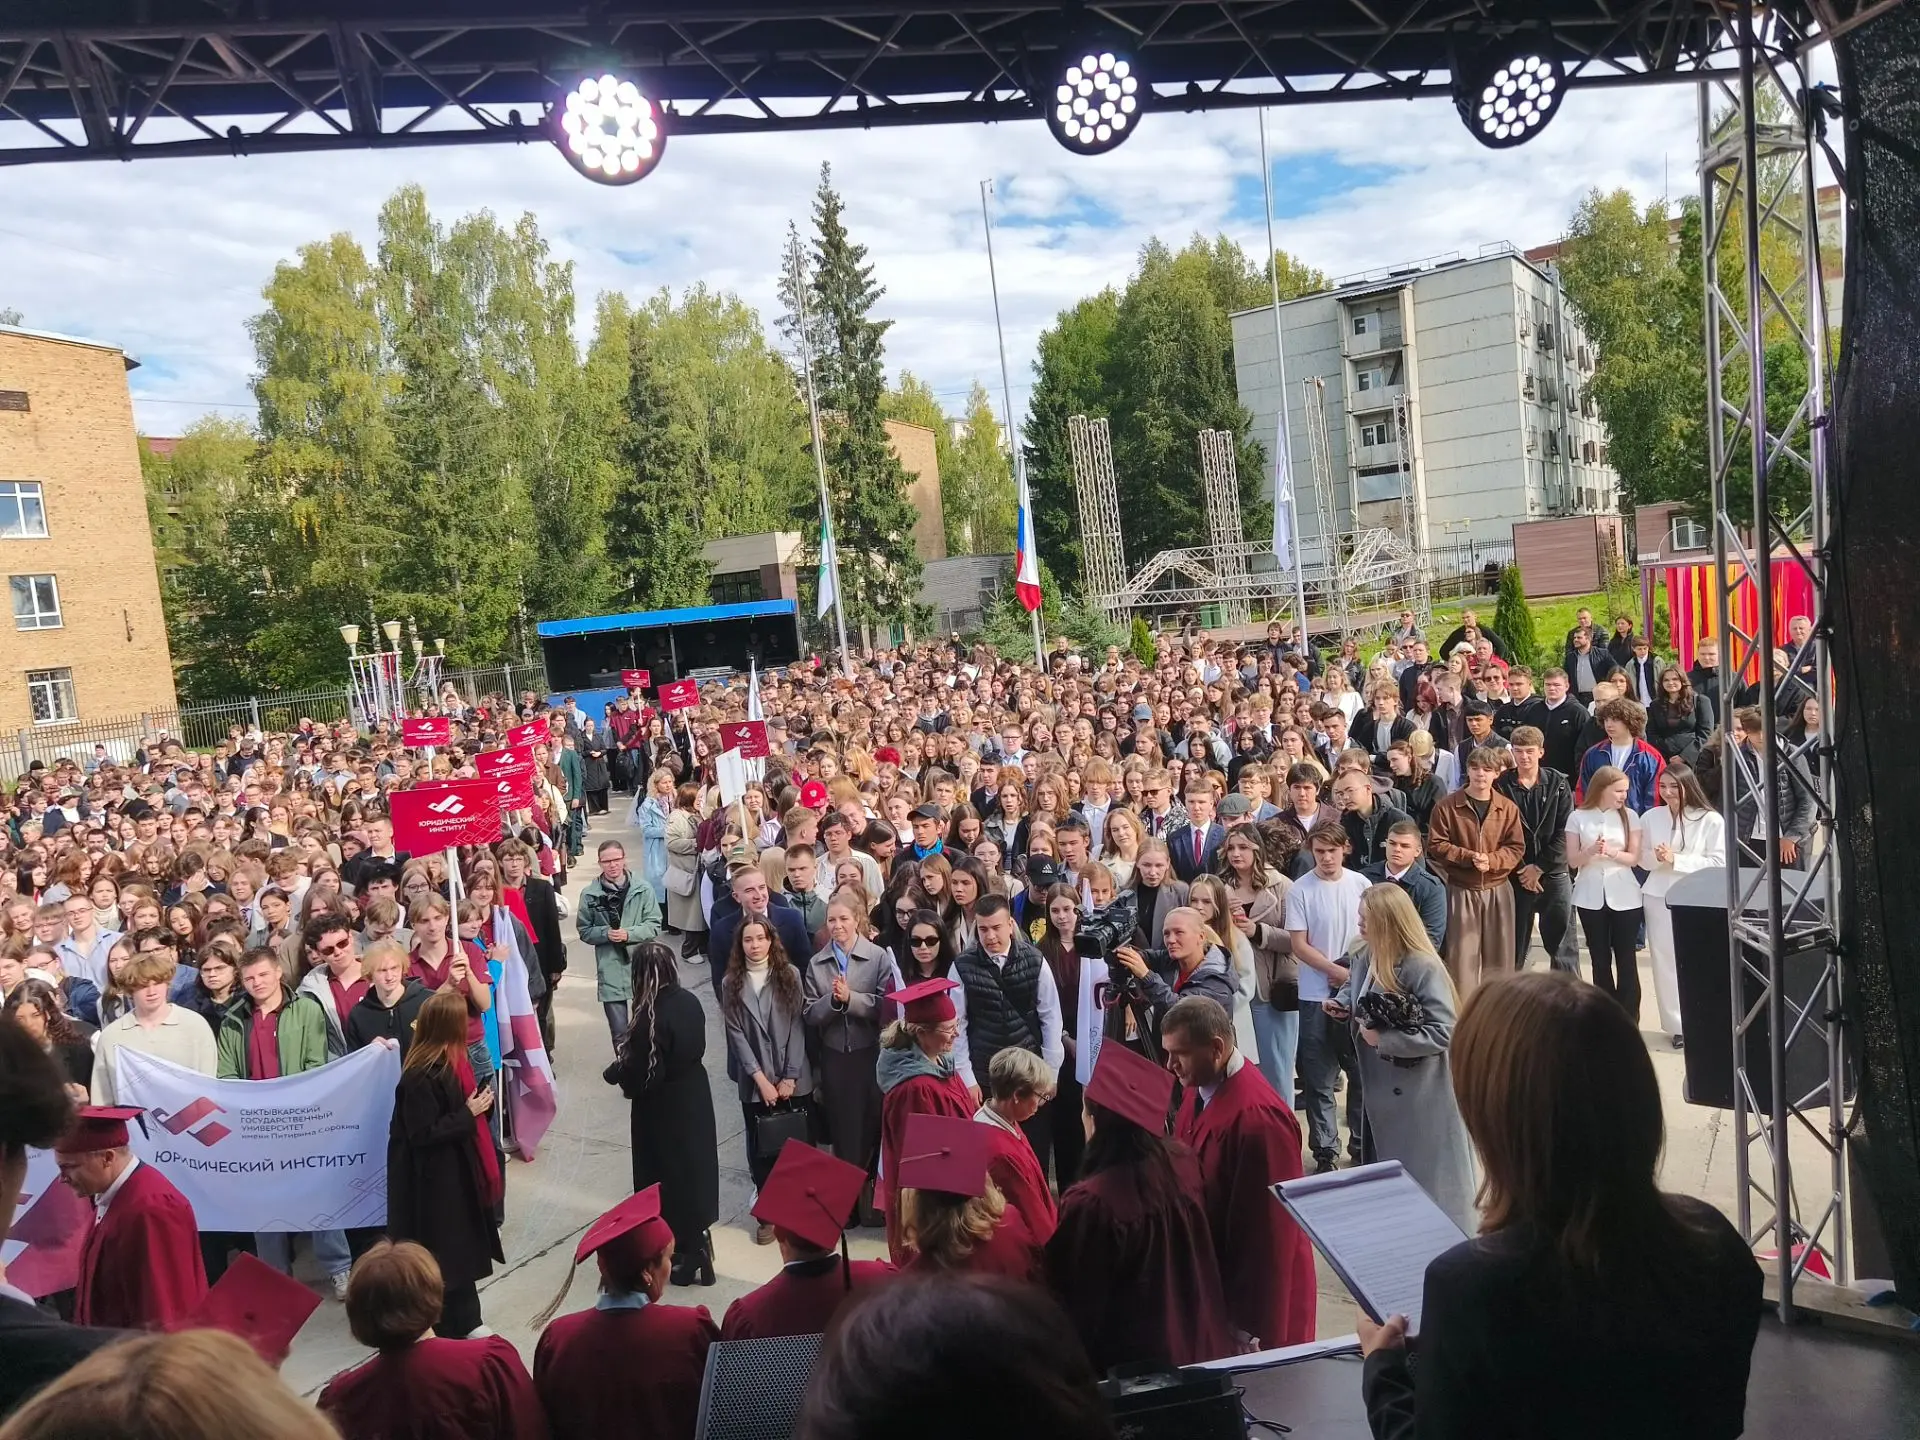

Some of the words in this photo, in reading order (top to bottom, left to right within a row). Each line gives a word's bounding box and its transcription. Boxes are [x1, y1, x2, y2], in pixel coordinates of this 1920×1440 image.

[418, 815, 475, 827] ЮРИДИЧЕСКИЙ
[429, 824, 466, 833] ИНСТИТУТ
[240, 1105, 321, 1116] СЫКТЫВКАРСКИЙ
[240, 1111, 333, 1124] ГОСУДАРСТВЕННЫЙ
[241, 1123, 304, 1132] УНИВЕРСИТЕТ
[155, 1150, 275, 1173] ЮРИДИЧЕСКИЙ
[280, 1152, 367, 1171] ИНСТИТУТ
